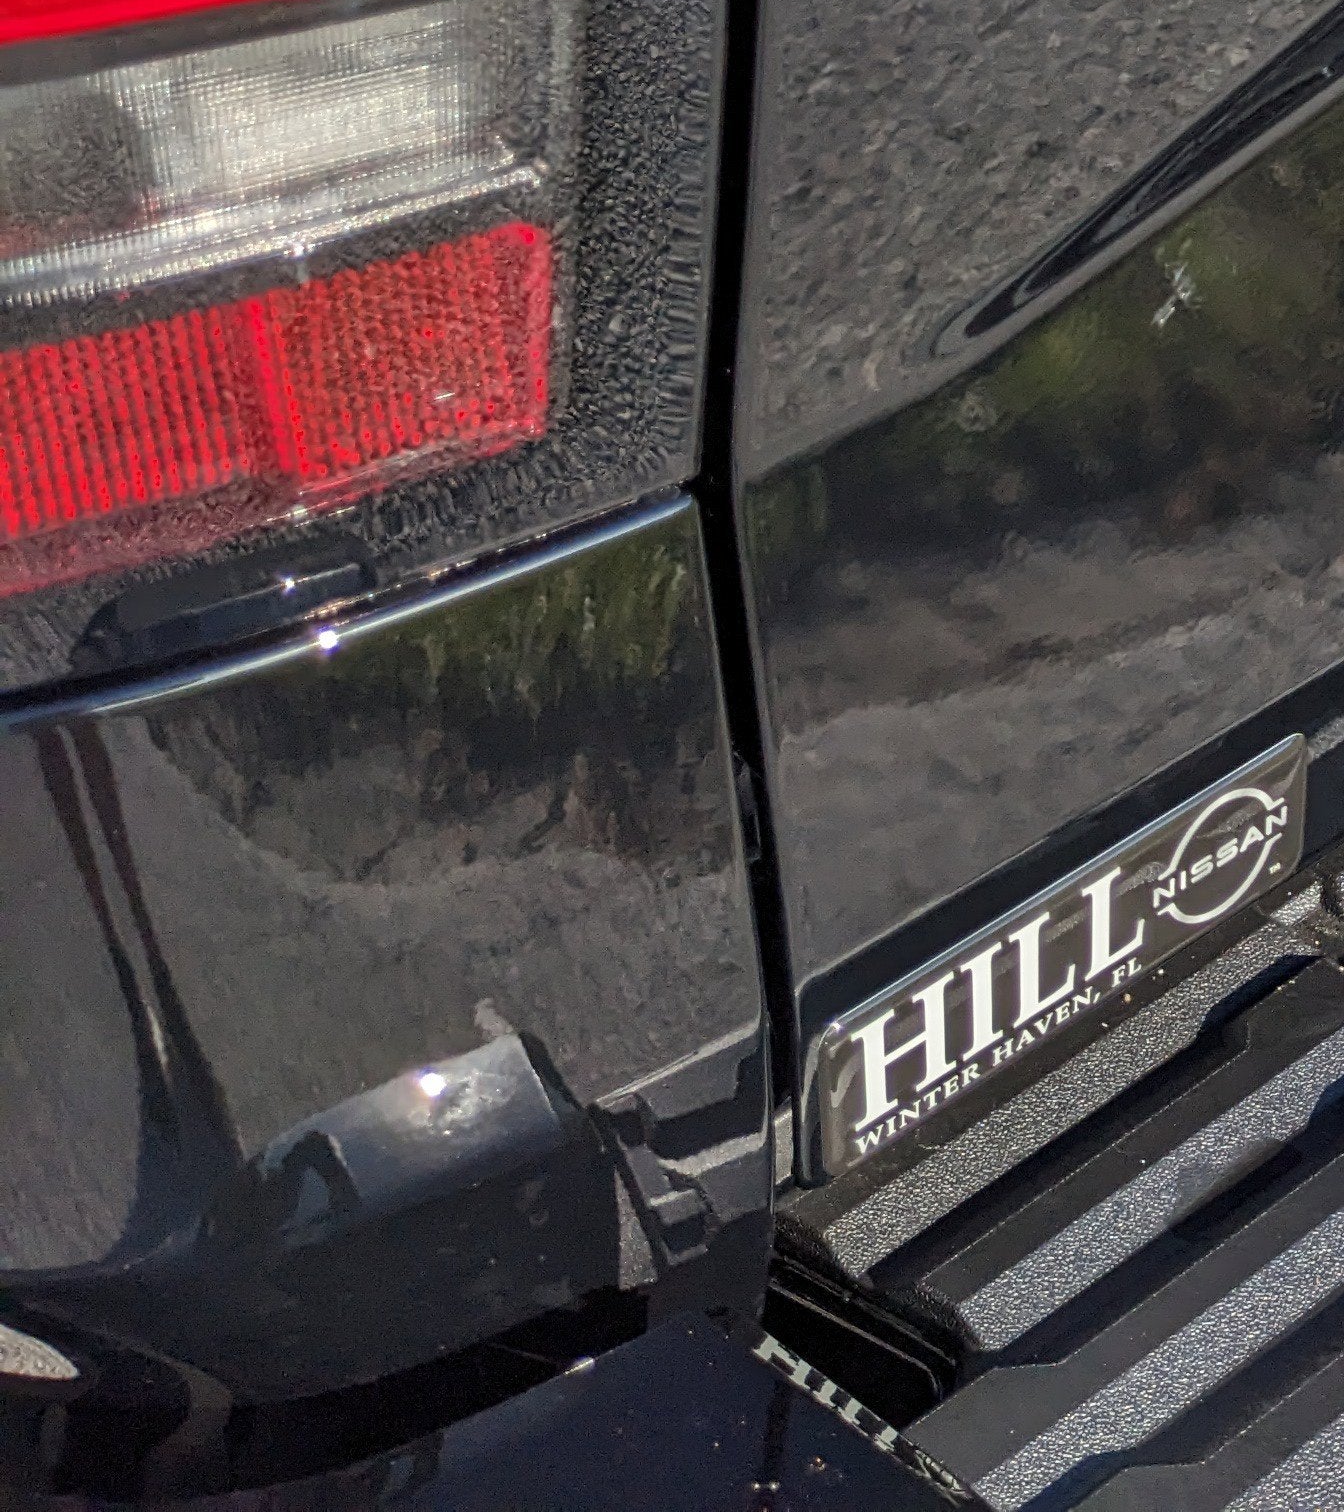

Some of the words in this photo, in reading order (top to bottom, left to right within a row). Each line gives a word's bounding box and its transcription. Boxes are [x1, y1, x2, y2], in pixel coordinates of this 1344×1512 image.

[1152, 805, 1289, 908] NISSAN
[850, 866, 1145, 1132] HILL
[855, 1064, 982, 1155] WINTER
[991, 985, 1101, 1068] HAVEN,
[1111, 958, 1143, 989] FL
